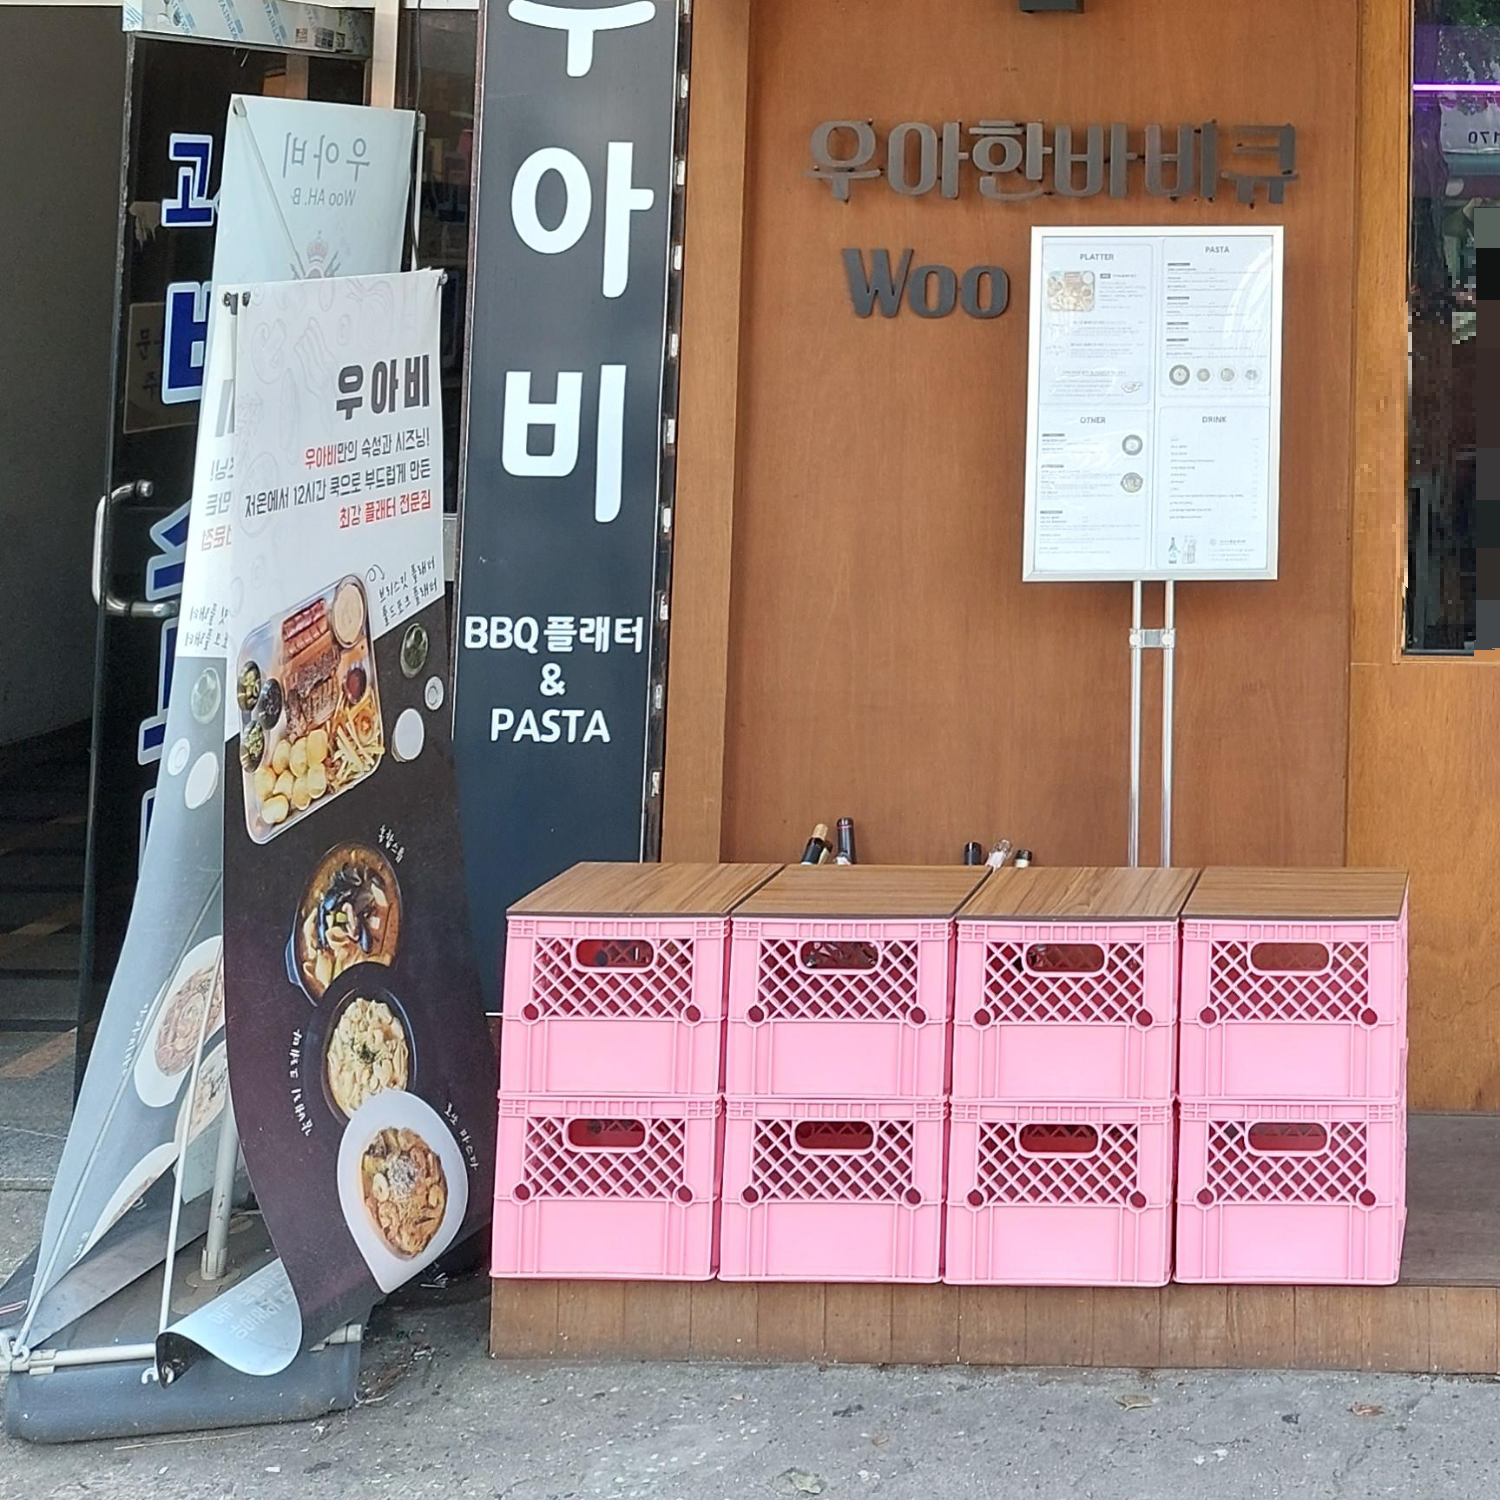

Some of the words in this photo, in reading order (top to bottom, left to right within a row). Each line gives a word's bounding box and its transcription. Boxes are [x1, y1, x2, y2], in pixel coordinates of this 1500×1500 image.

[1079, 253, 1114, 261] PLATTER
[1205, 245, 1230, 254] PASTA
[842, 247, 1010, 319] Woo
[335, 354, 431, 421] 우아비
[1079, 415, 1106, 425] OTHER
[1202, 415, 1227, 424] DRINK
[305, 439, 358, 470] 우아비만의
[361, 434, 392, 460] 숙성과
[395, 426, 430, 454] 시즈닝!
[245, 486, 290, 518] 저온에서
[293, 479, 327, 507] 12시간
[365, 463, 407, 490] 부드럽게
[409, 457, 431, 481] 만든
[339, 504, 361, 529] 최강
[365, 497, 397, 523] 플래터
[538, 663, 567, 696] &
[490, 709, 611, 743] PASTA
